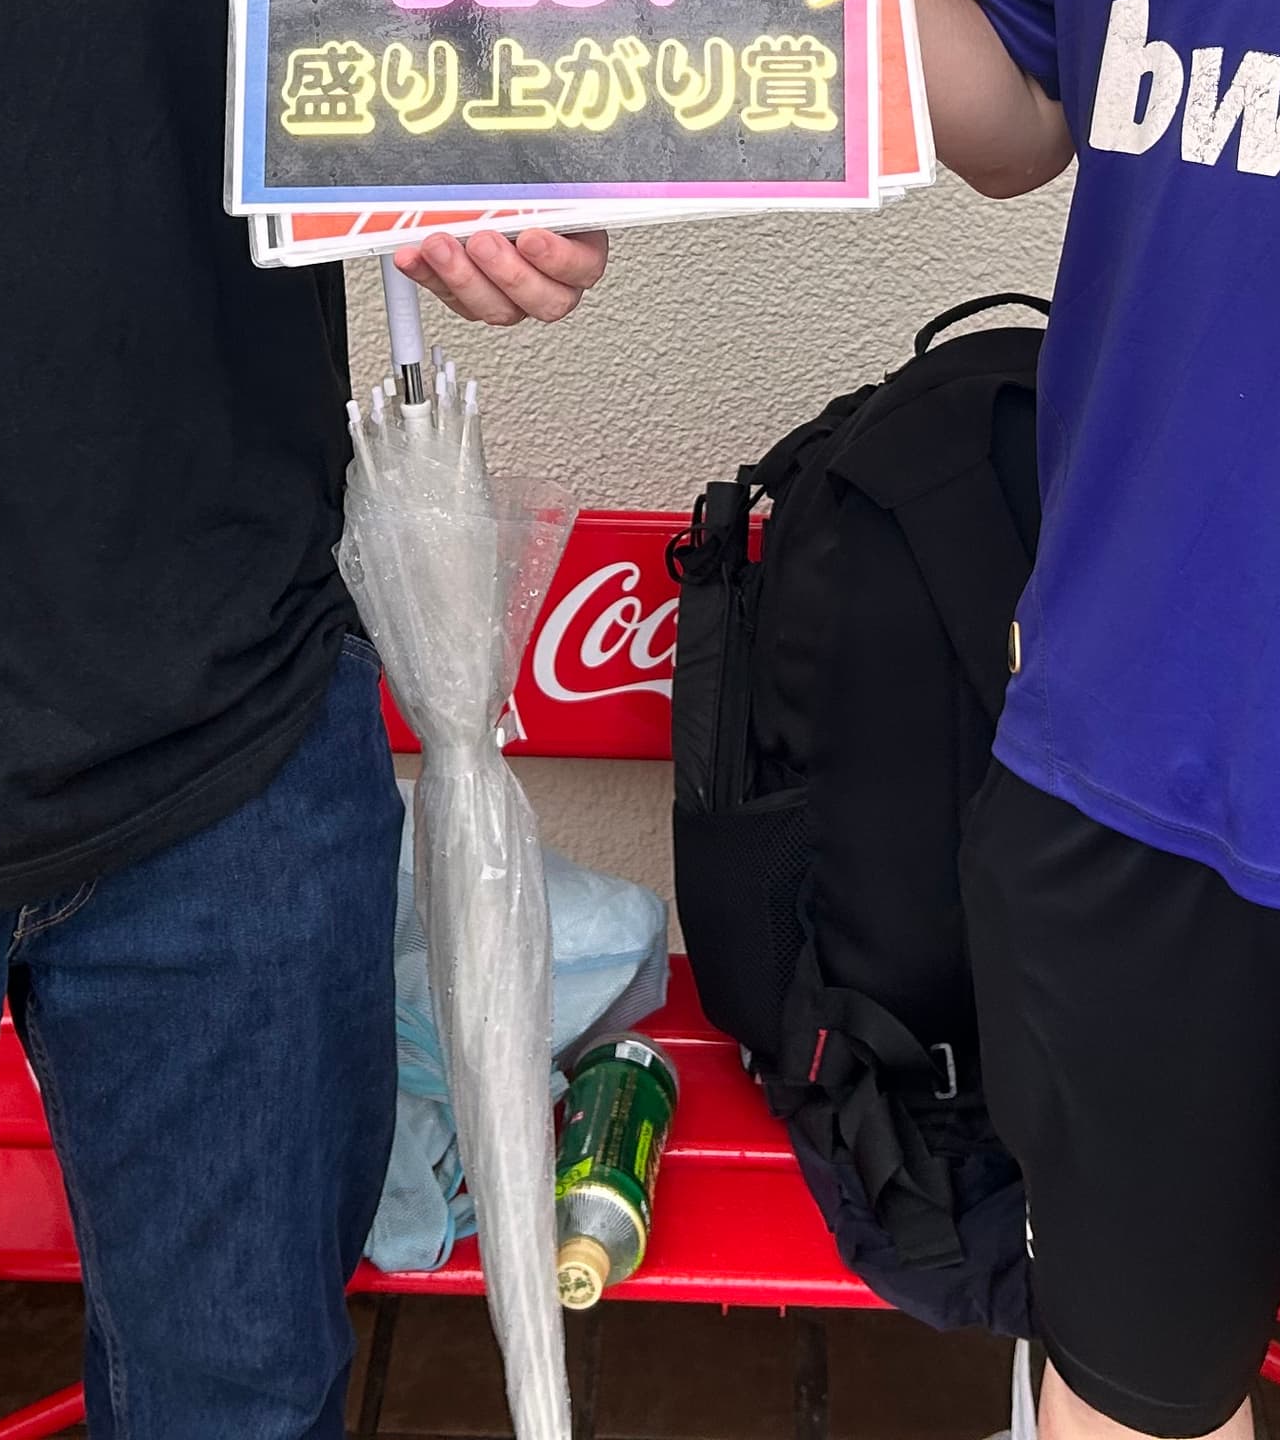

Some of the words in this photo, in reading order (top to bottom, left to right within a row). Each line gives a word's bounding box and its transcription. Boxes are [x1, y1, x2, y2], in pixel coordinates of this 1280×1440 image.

[280, 35, 840, 135] 盛り上がり賞
